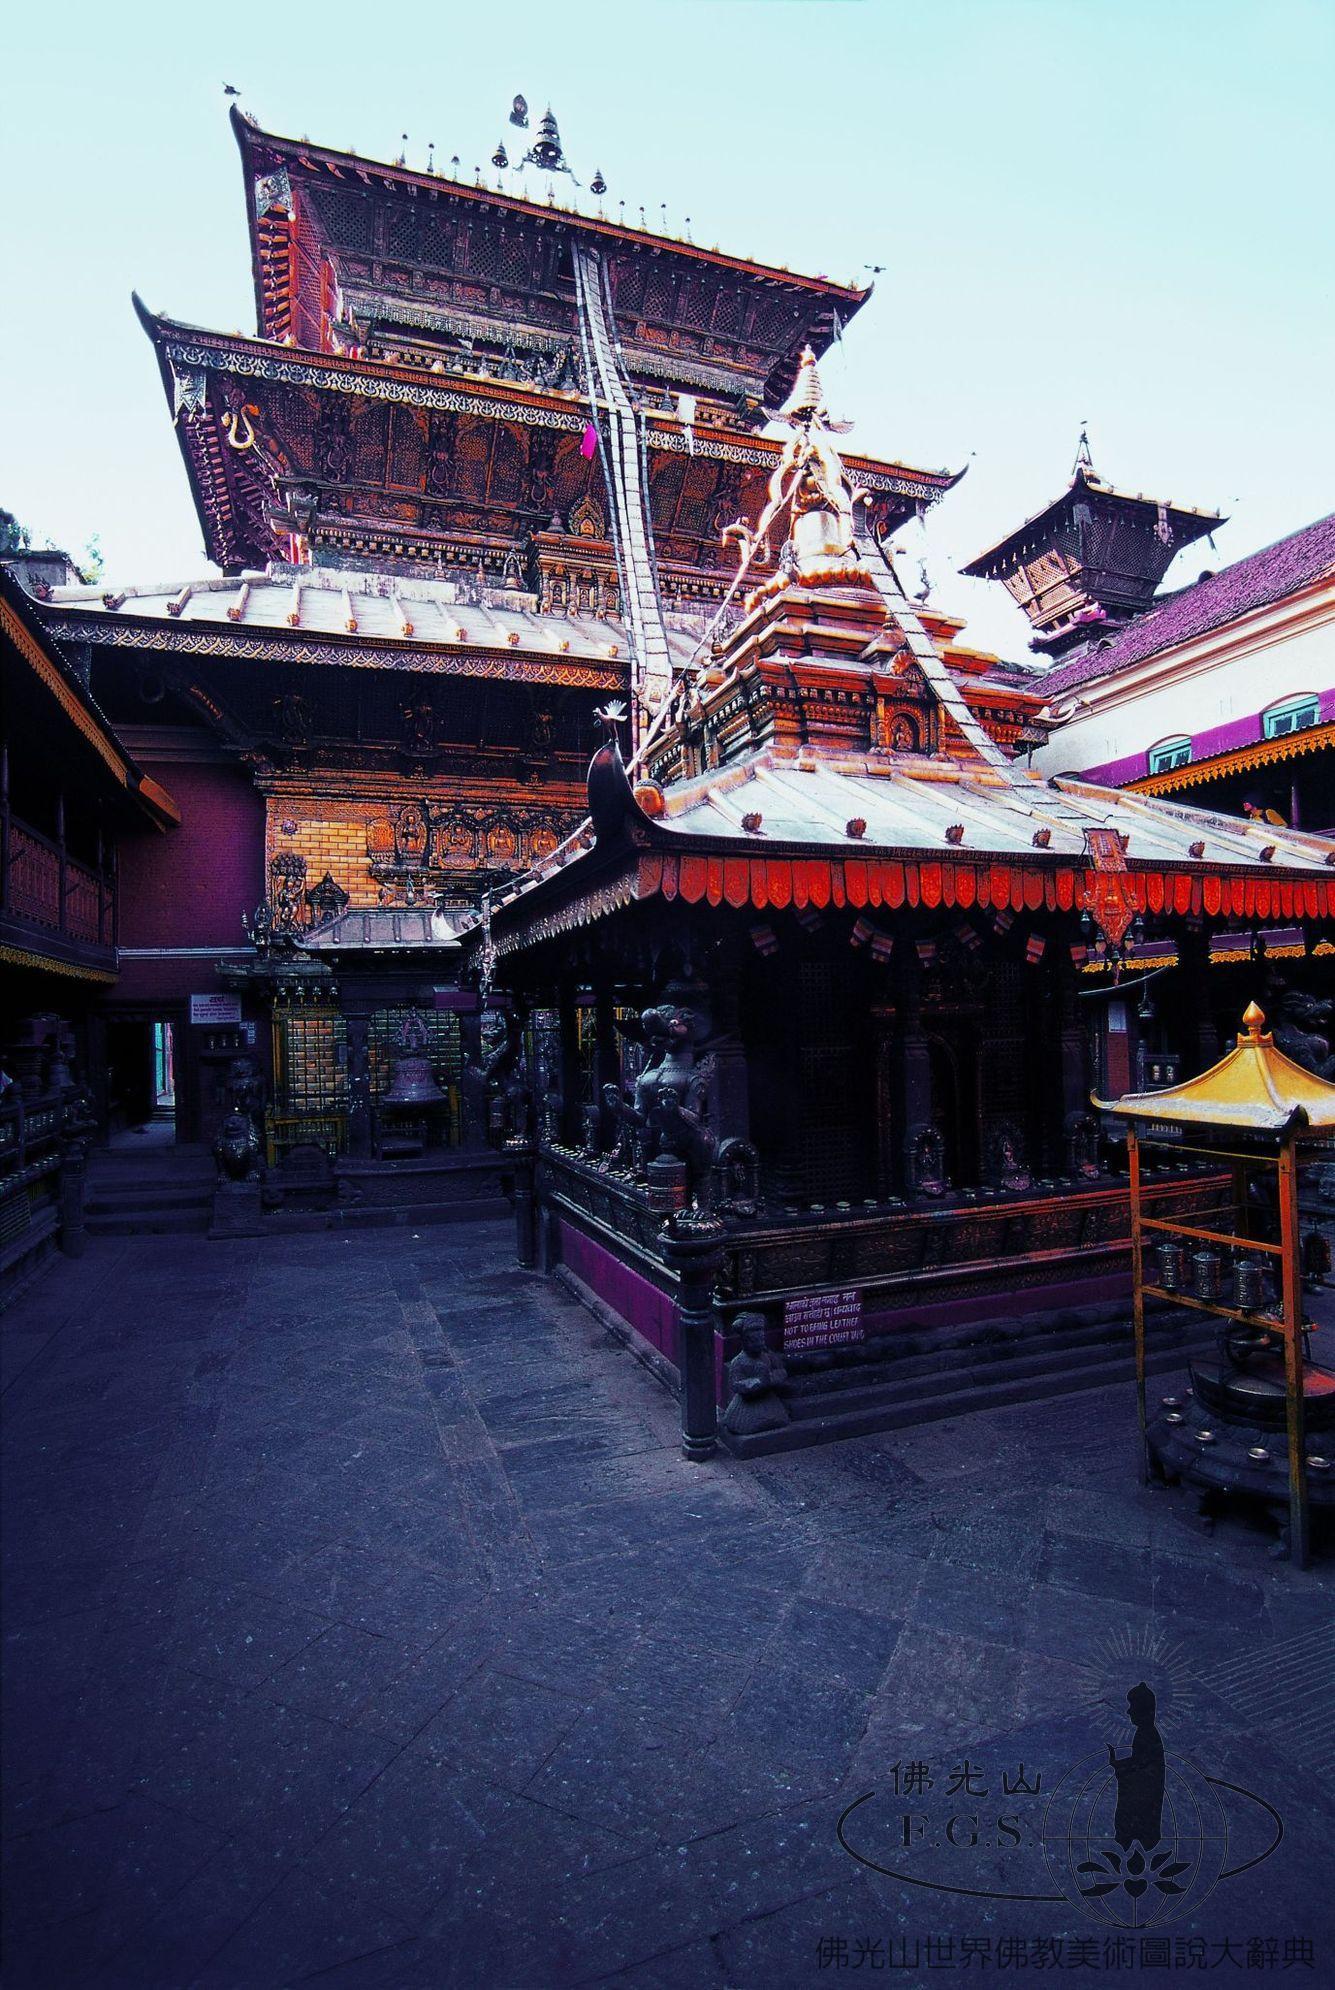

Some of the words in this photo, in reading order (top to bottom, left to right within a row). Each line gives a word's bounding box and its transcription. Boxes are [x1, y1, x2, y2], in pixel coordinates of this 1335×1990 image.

[784, 1326, 798, 1336] NOT
[800, 1324, 809, 1333] TO
[809, 1321, 828, 1331] BRING
[830, 1317, 859, 1328] LEATHER
[784, 1338, 806, 1349] SHOES
[806, 1337, 814, 1346] IN
[815, 1334, 827, 1345] THE
[828, 1331, 849, 1344] COURT
